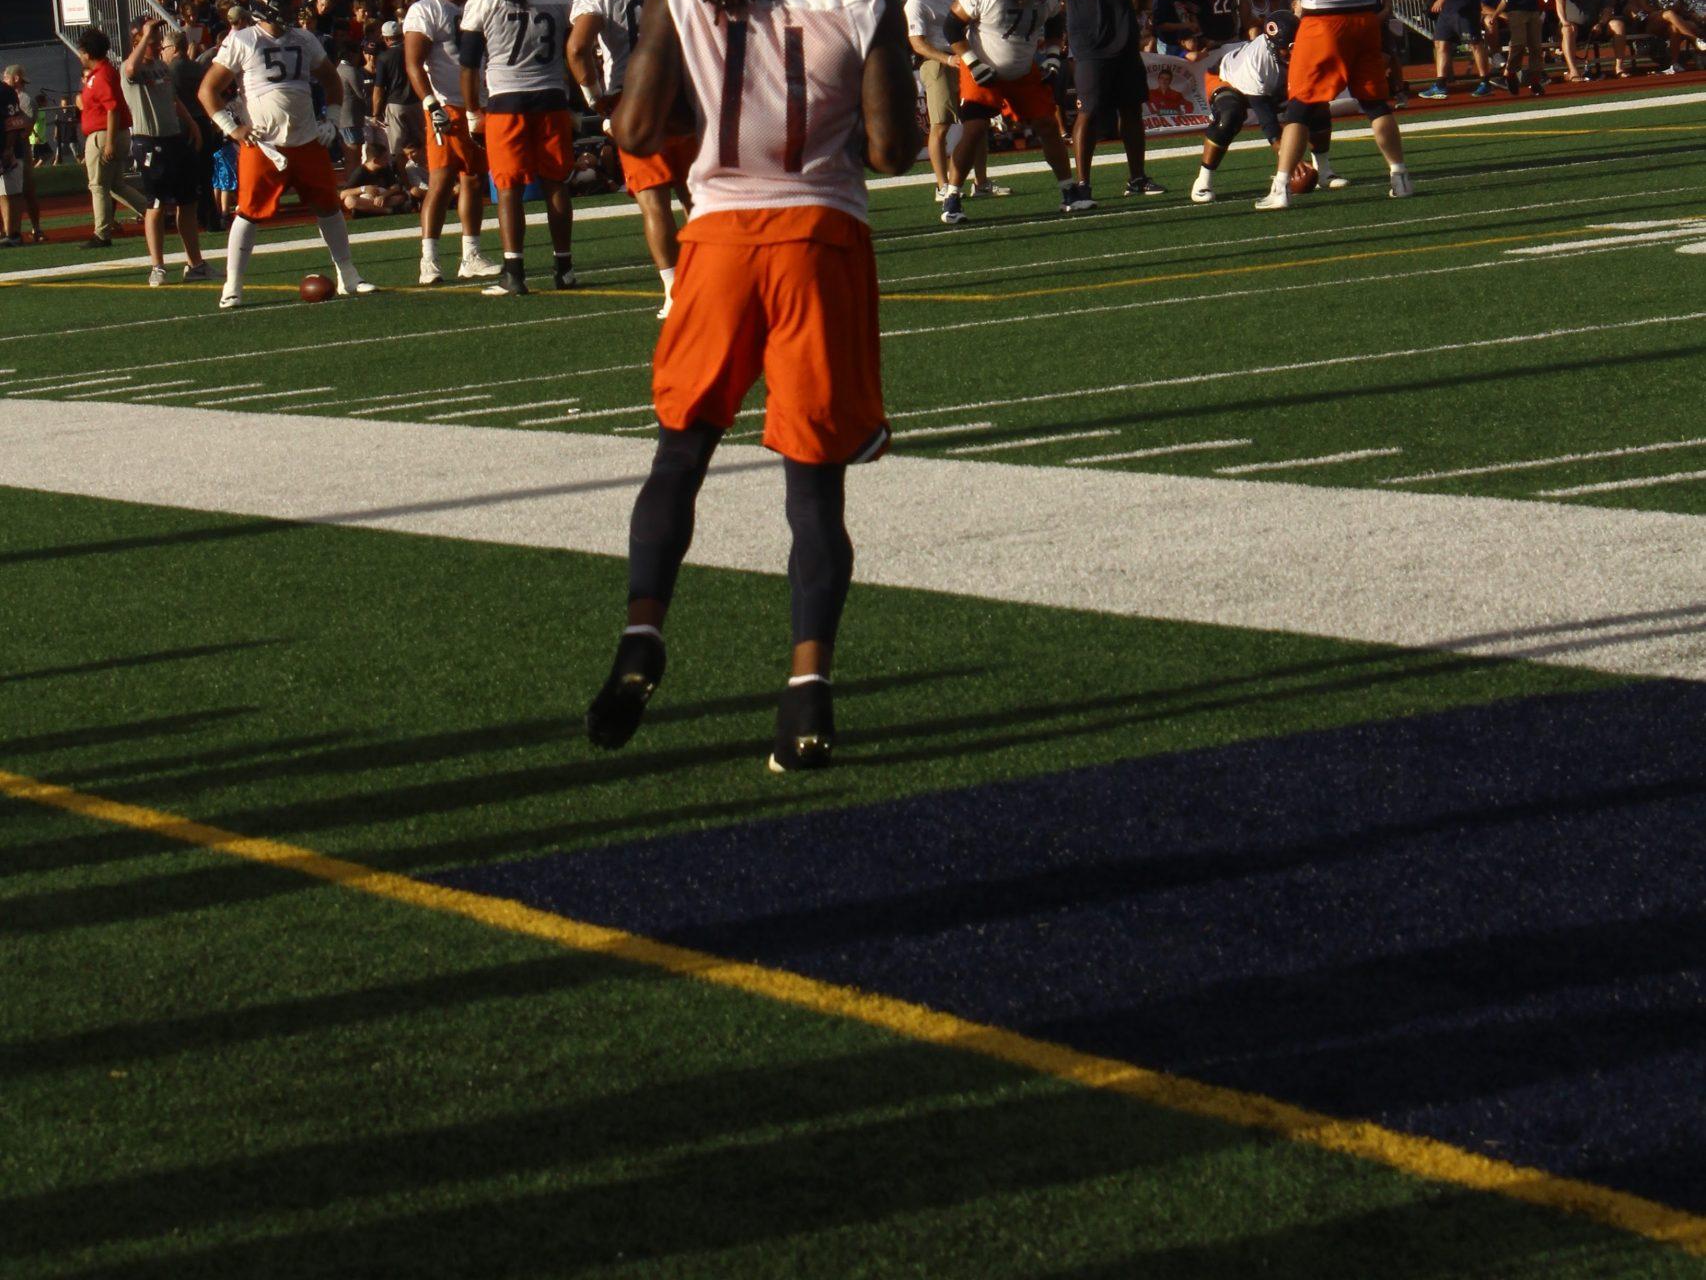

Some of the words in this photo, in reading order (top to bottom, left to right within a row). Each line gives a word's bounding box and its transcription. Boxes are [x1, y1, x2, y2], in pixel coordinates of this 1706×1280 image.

[507, 11, 557, 66] 73
[1002, 9, 1039, 42] 71
[263, 45, 302, 83] 57
[719, 20, 808, 172] 11
